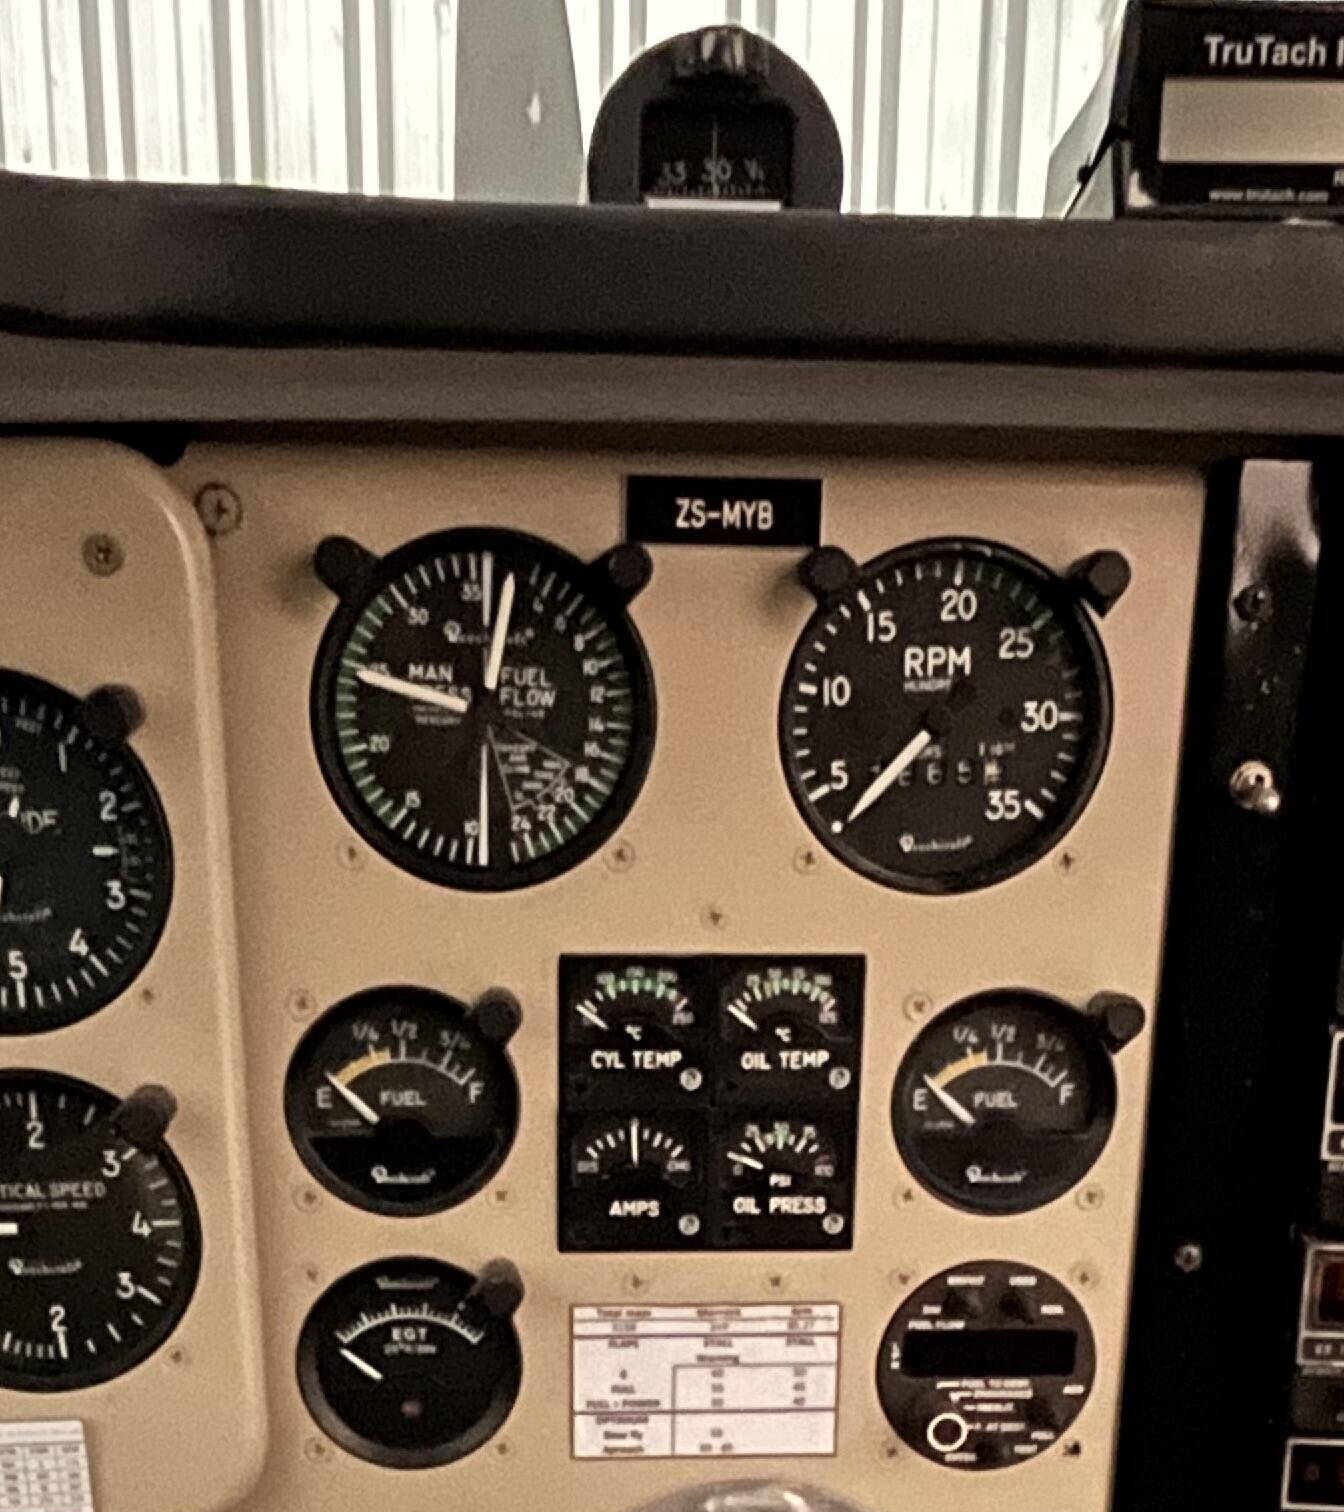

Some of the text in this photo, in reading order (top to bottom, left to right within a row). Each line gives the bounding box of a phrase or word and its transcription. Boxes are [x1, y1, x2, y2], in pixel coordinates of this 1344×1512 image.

[1204, 34, 1326, 67] TruTach
[675, 498, 773, 530] ZS-MYB
[407, 607, 430, 626] 30
[940, 588, 979, 622] 20
[866, 610, 897, 644] 15
[999, 626, 1035, 660] 25
[408, 662, 454, 683] MAN
[903, 645, 972, 678] RPM
[500, 667, 553, 687] FUEL
[822, 675, 852, 707] 10
[499, 688, 556, 709] FLOW
[1020, 700, 1059, 733] 30
[369, 733, 391, 752] 20
[830, 759, 849, 792] 5
[98, 790, 118, 821] 2
[985, 788, 1022, 822] 35
[106, 880, 126, 910] 3
[68, 928, 90, 957] 4
[8, 950, 28, 980] 5
[591, 1049, 683, 1069] CYL TEMP
[740, 1049, 830, 1070] OIL TEMP
[315, 1086, 334, 1109] E
[379, 1089, 428, 1107] FUEL
[469, 1081, 486, 1105] F
[913, 1088, 929, 1111] E
[973, 1091, 1019, 1109] FUEL
[1059, 1082, 1076, 1106] F
[27, 1120, 46, 1149] 2
[102, 1149, 123, 1178] 3
[50, 1181, 108, 1199] SPEED
[609, 1199, 661, 1218] AMPS
[732, 1195, 827, 1215] OIL PRESS
[132, 1211, 153, 1238] 4
[117, 1271, 136, 1300] 3
[49, 1304, 66, 1333] 2
